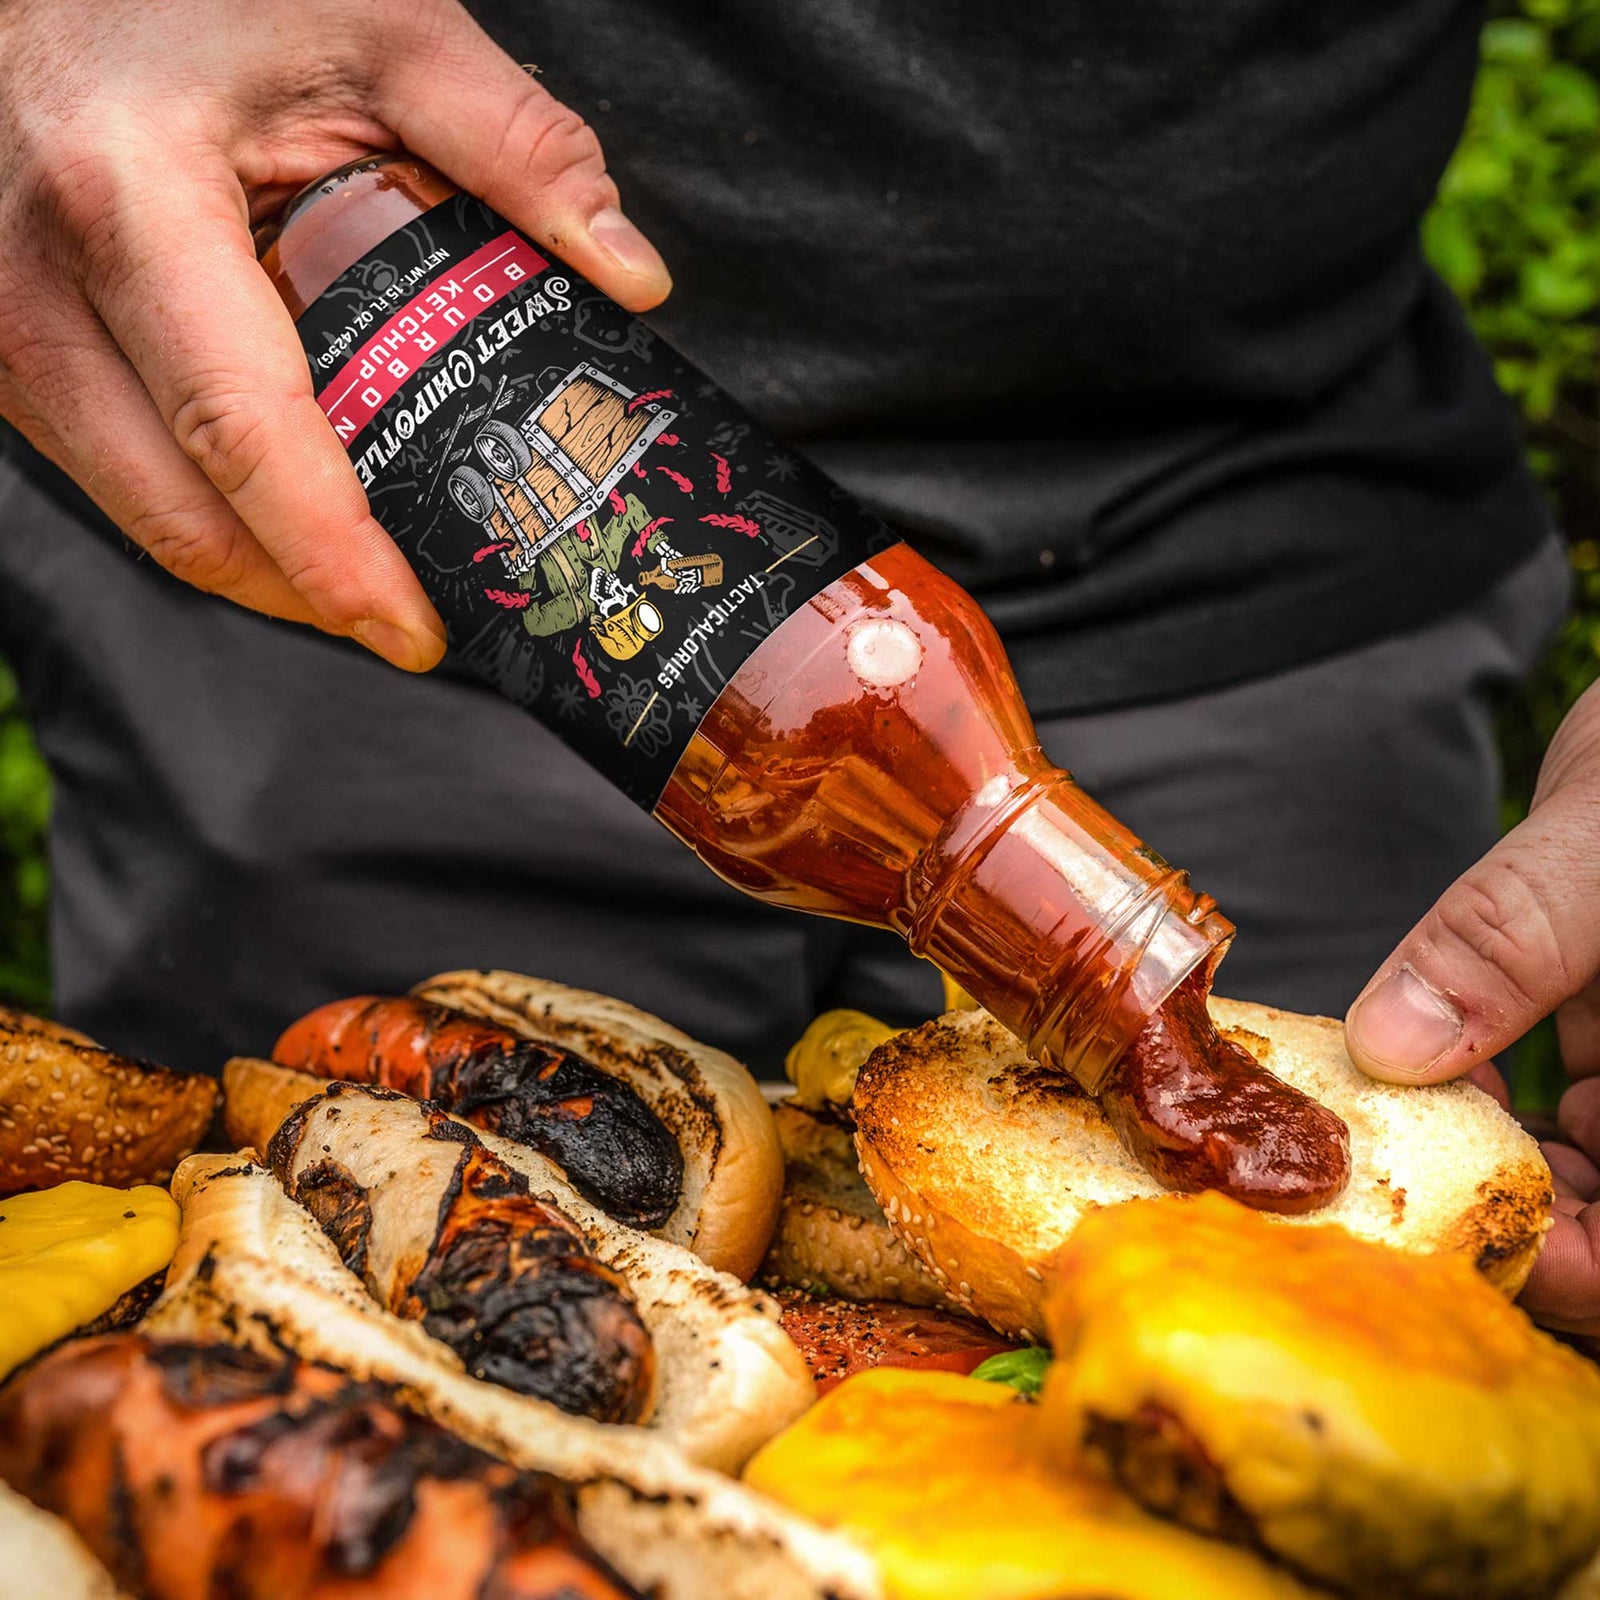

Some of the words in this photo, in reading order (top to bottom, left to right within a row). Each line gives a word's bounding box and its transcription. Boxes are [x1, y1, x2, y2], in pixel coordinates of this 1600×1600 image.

[400, 266, 427, 286] WT.
[424, 248, 450, 270] NET
[369, 297, 389, 312] FL
[385, 284, 404, 300] 15
[353, 311, 374, 330] OZ
[359, 279, 464, 380] KETCHUP
[477, 276, 572, 365] SWEET
[334, 262, 526, 440] BOURBON
[353, 349, 475, 490] CHIPOTLE
[657, 574, 764, 689] TACTICALORIES
